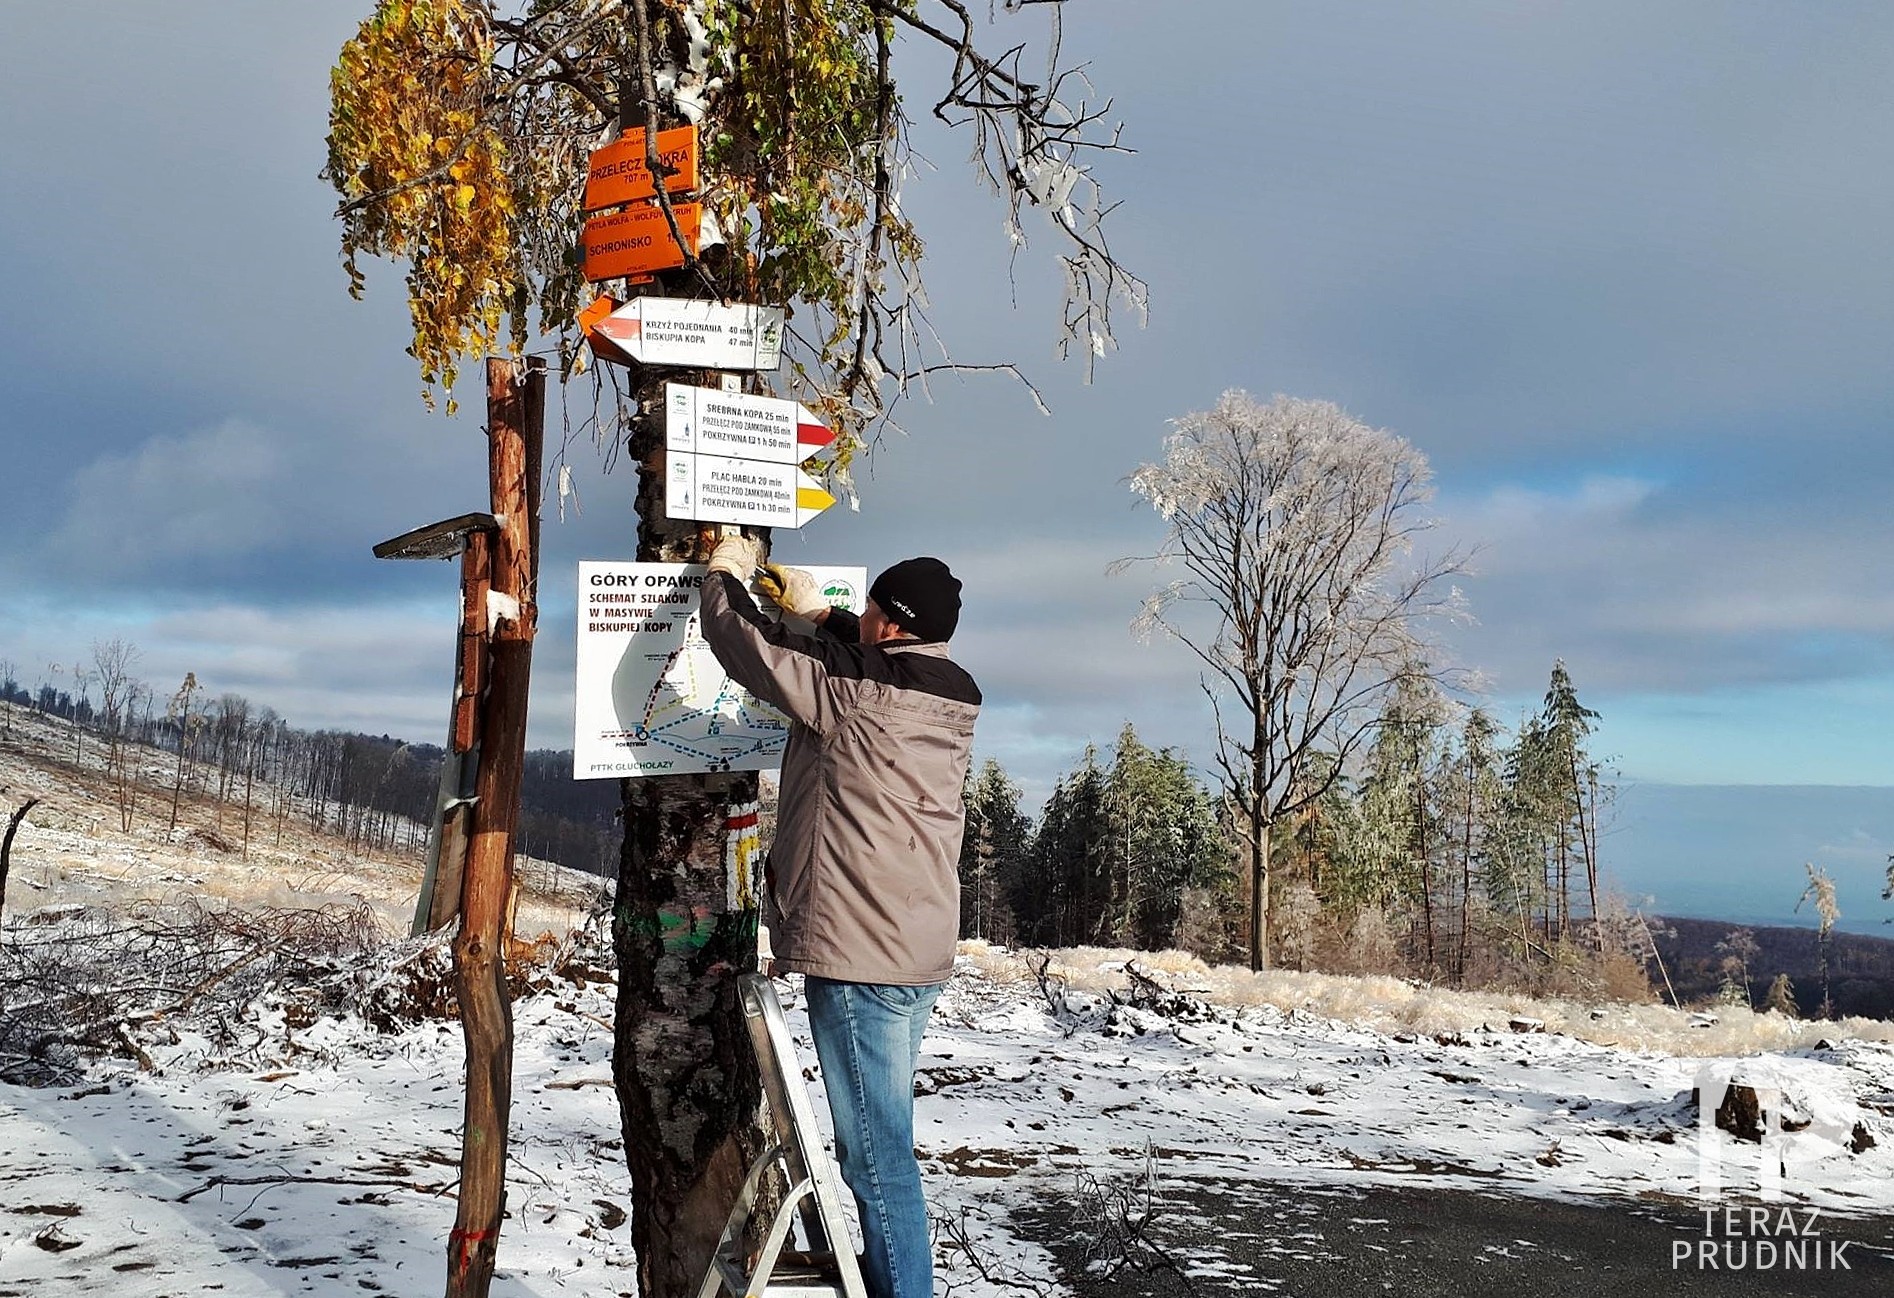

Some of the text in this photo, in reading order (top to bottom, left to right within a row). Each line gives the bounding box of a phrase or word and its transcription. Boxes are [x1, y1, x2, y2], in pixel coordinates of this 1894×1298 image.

[624, 172, 649, 183] 707 m
[607, 215, 630, 226] WOLFA
[589, 235, 652, 256] SCHRONISKO
[645, 319, 754, 336] KRZYŻ POJEDNANIA 40 min
[645, 332, 753, 347] BISKUPIA KOPA 47 min
[706, 404, 789, 423] SREBRNA KOPA 25 min
[731, 420, 744, 430] POD
[744, 422, 773, 435] ZAMKOWĄ
[780, 427, 791, 435] min
[702, 430, 747, 444] POKRZYWNA
[757, 436, 761, 445] 1
[762, 437, 768, 447] h
[768, 438, 778, 448] 50
[778, 440, 791, 449] min
[711, 471, 783, 487] PLAC HABLA 20 min
[731, 486, 744, 496] POD
[744, 488, 773, 501] ZAMKOWĄ
[702, 497, 747, 510] POKRZYWNA
[757, 502, 761, 511] 1
[762, 503, 767, 511] h
[767, 504, 777, 513] 30
[777, 505, 791, 514] min
[590, 572, 705, 588] GÓRY OPAWS
[589, 591, 690, 604] SCHEMAT SZLAKÓW
[589, 608, 653, 618] W MASYWIE
[589, 622, 673, 633] BISKUPIEJ KOPY
[590, 761, 674, 772] PTTK GŁUCHOŁAZY
